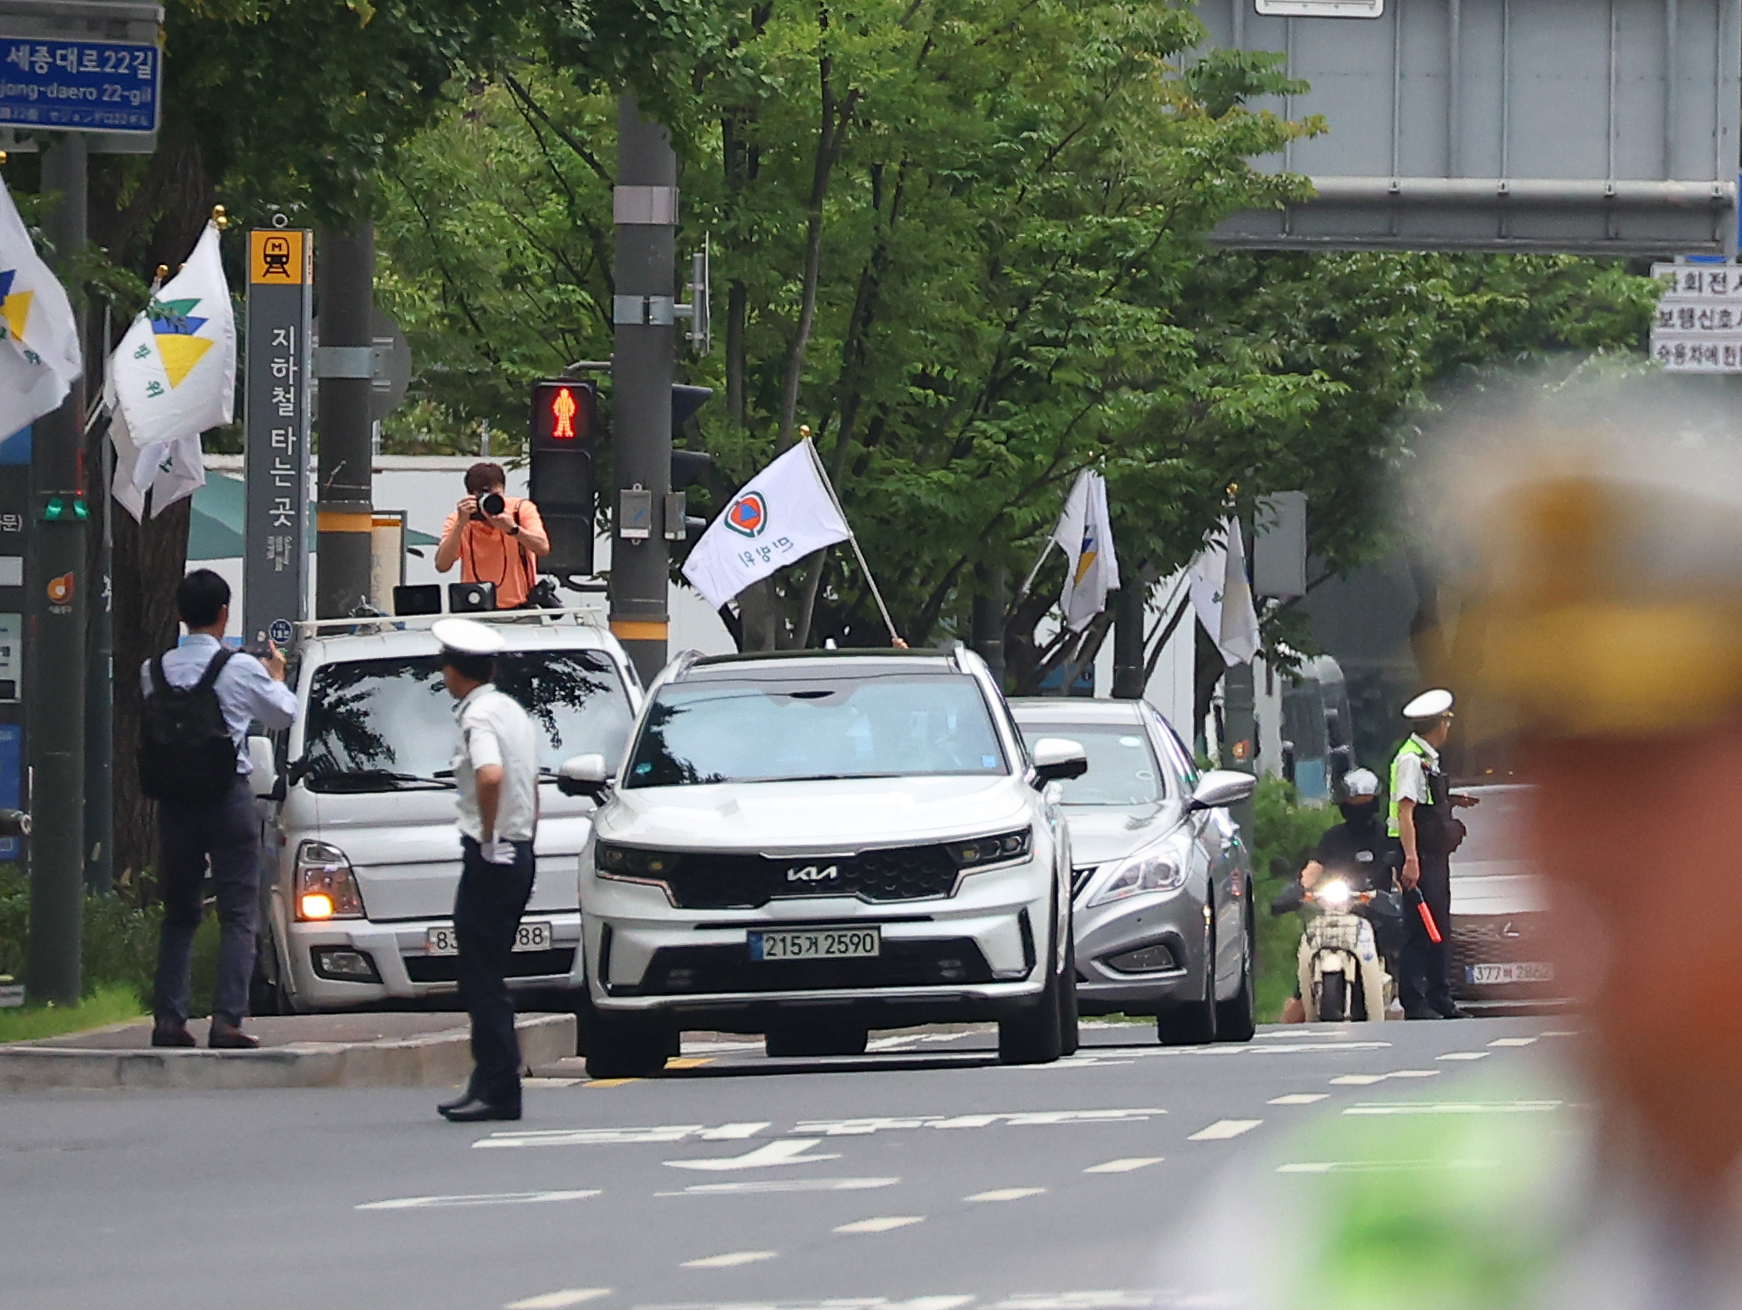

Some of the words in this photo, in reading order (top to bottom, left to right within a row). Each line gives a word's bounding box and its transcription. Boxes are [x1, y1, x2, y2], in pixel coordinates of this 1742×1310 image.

[6, 44, 152, 79] 세종대로22길
[271, 325, 298, 417] 지하철
[270, 426, 297, 487] 타는
[0, 514, 23, 532] 문)
[268, 497, 296, 527] 곳
[787, 866, 838, 881] KIA
[765, 935, 818, 957] 215거
[824, 932, 875, 955] 2590
